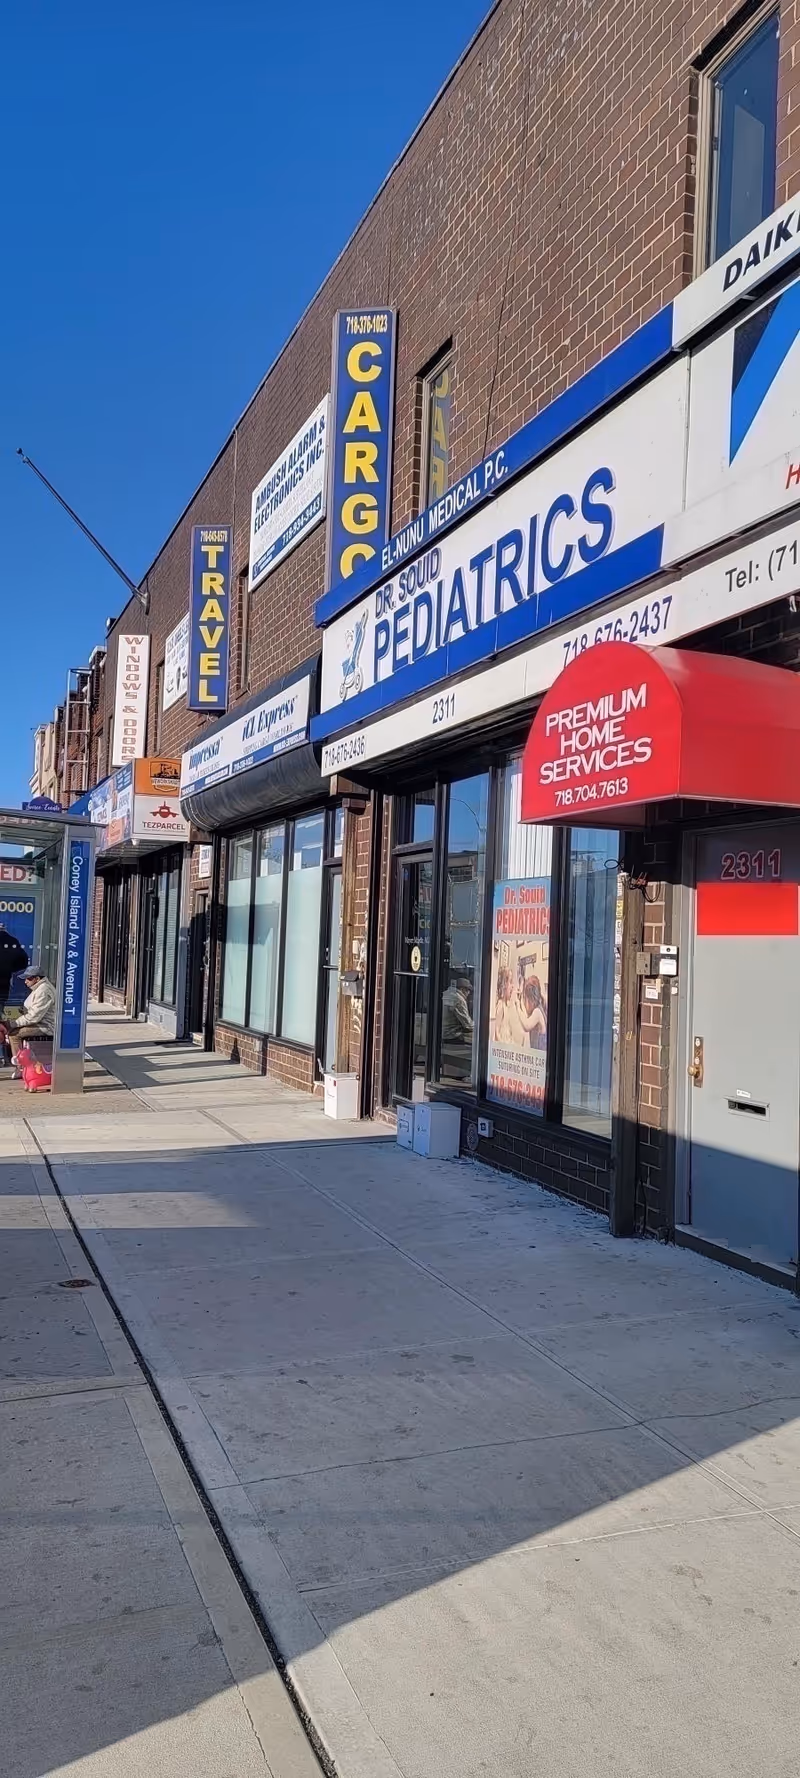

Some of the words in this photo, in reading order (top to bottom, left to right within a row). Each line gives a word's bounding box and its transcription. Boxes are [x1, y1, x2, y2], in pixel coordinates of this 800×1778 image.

[722, 208, 800, 293] DAIK
[346, 314, 388, 335] 718-376-1023
[255, 460, 287, 513] AMBUSH
[287, 423, 317, 472] ALARM
[318, 414, 326, 433] &
[254, 464, 305, 535] ELECTRONICS
[306, 437, 325, 473] INC.
[381, 515, 424, 571] EL-NUNU
[428, 475, 481, 533] MEDICAL
[484, 450, 508, 490] P.C.
[373, 465, 617, 684] PEDIATRICS
[375, 580, 396, 620] DR.
[398, 546, 443, 602] SOUID
[725, 560, 760, 593] Tel:
[198, 545, 225, 703] TRAVEL
[563, 595, 673, 668] 718676-2437
[122, 636, 145, 700] WINDOWS
[432, 692, 456, 725] 2311
[545, 682, 647, 738] PREMIUM
[325, 735, 365, 768] 718-676-2436
[560, 716, 626, 756] HOME
[539, 737, 653, 785] SERVICES
[554, 777, 629, 807] 718.704.7613
[142, 820, 186, 831] TEZPARCEL
[68, 856, 84, 893] Coney
[721, 848, 782, 880] 2311
[68, 895, 81, 929] Island
[504, 887, 516, 905] Dr.
[66, 949, 79, 959] &
[68, 932, 80, 948] Av
[64, 961, 78, 1004] Avenue
[64, 1006, 76, 1015] T
[492, 1047, 514, 1061] INTENSIVE
[515, 1052, 534, 1066] ASTHMA
[498, 1061, 520, 1074] SUTURING
[521, 1066, 529, 1076] ON
[529, 1069, 540, 1079] SITE
